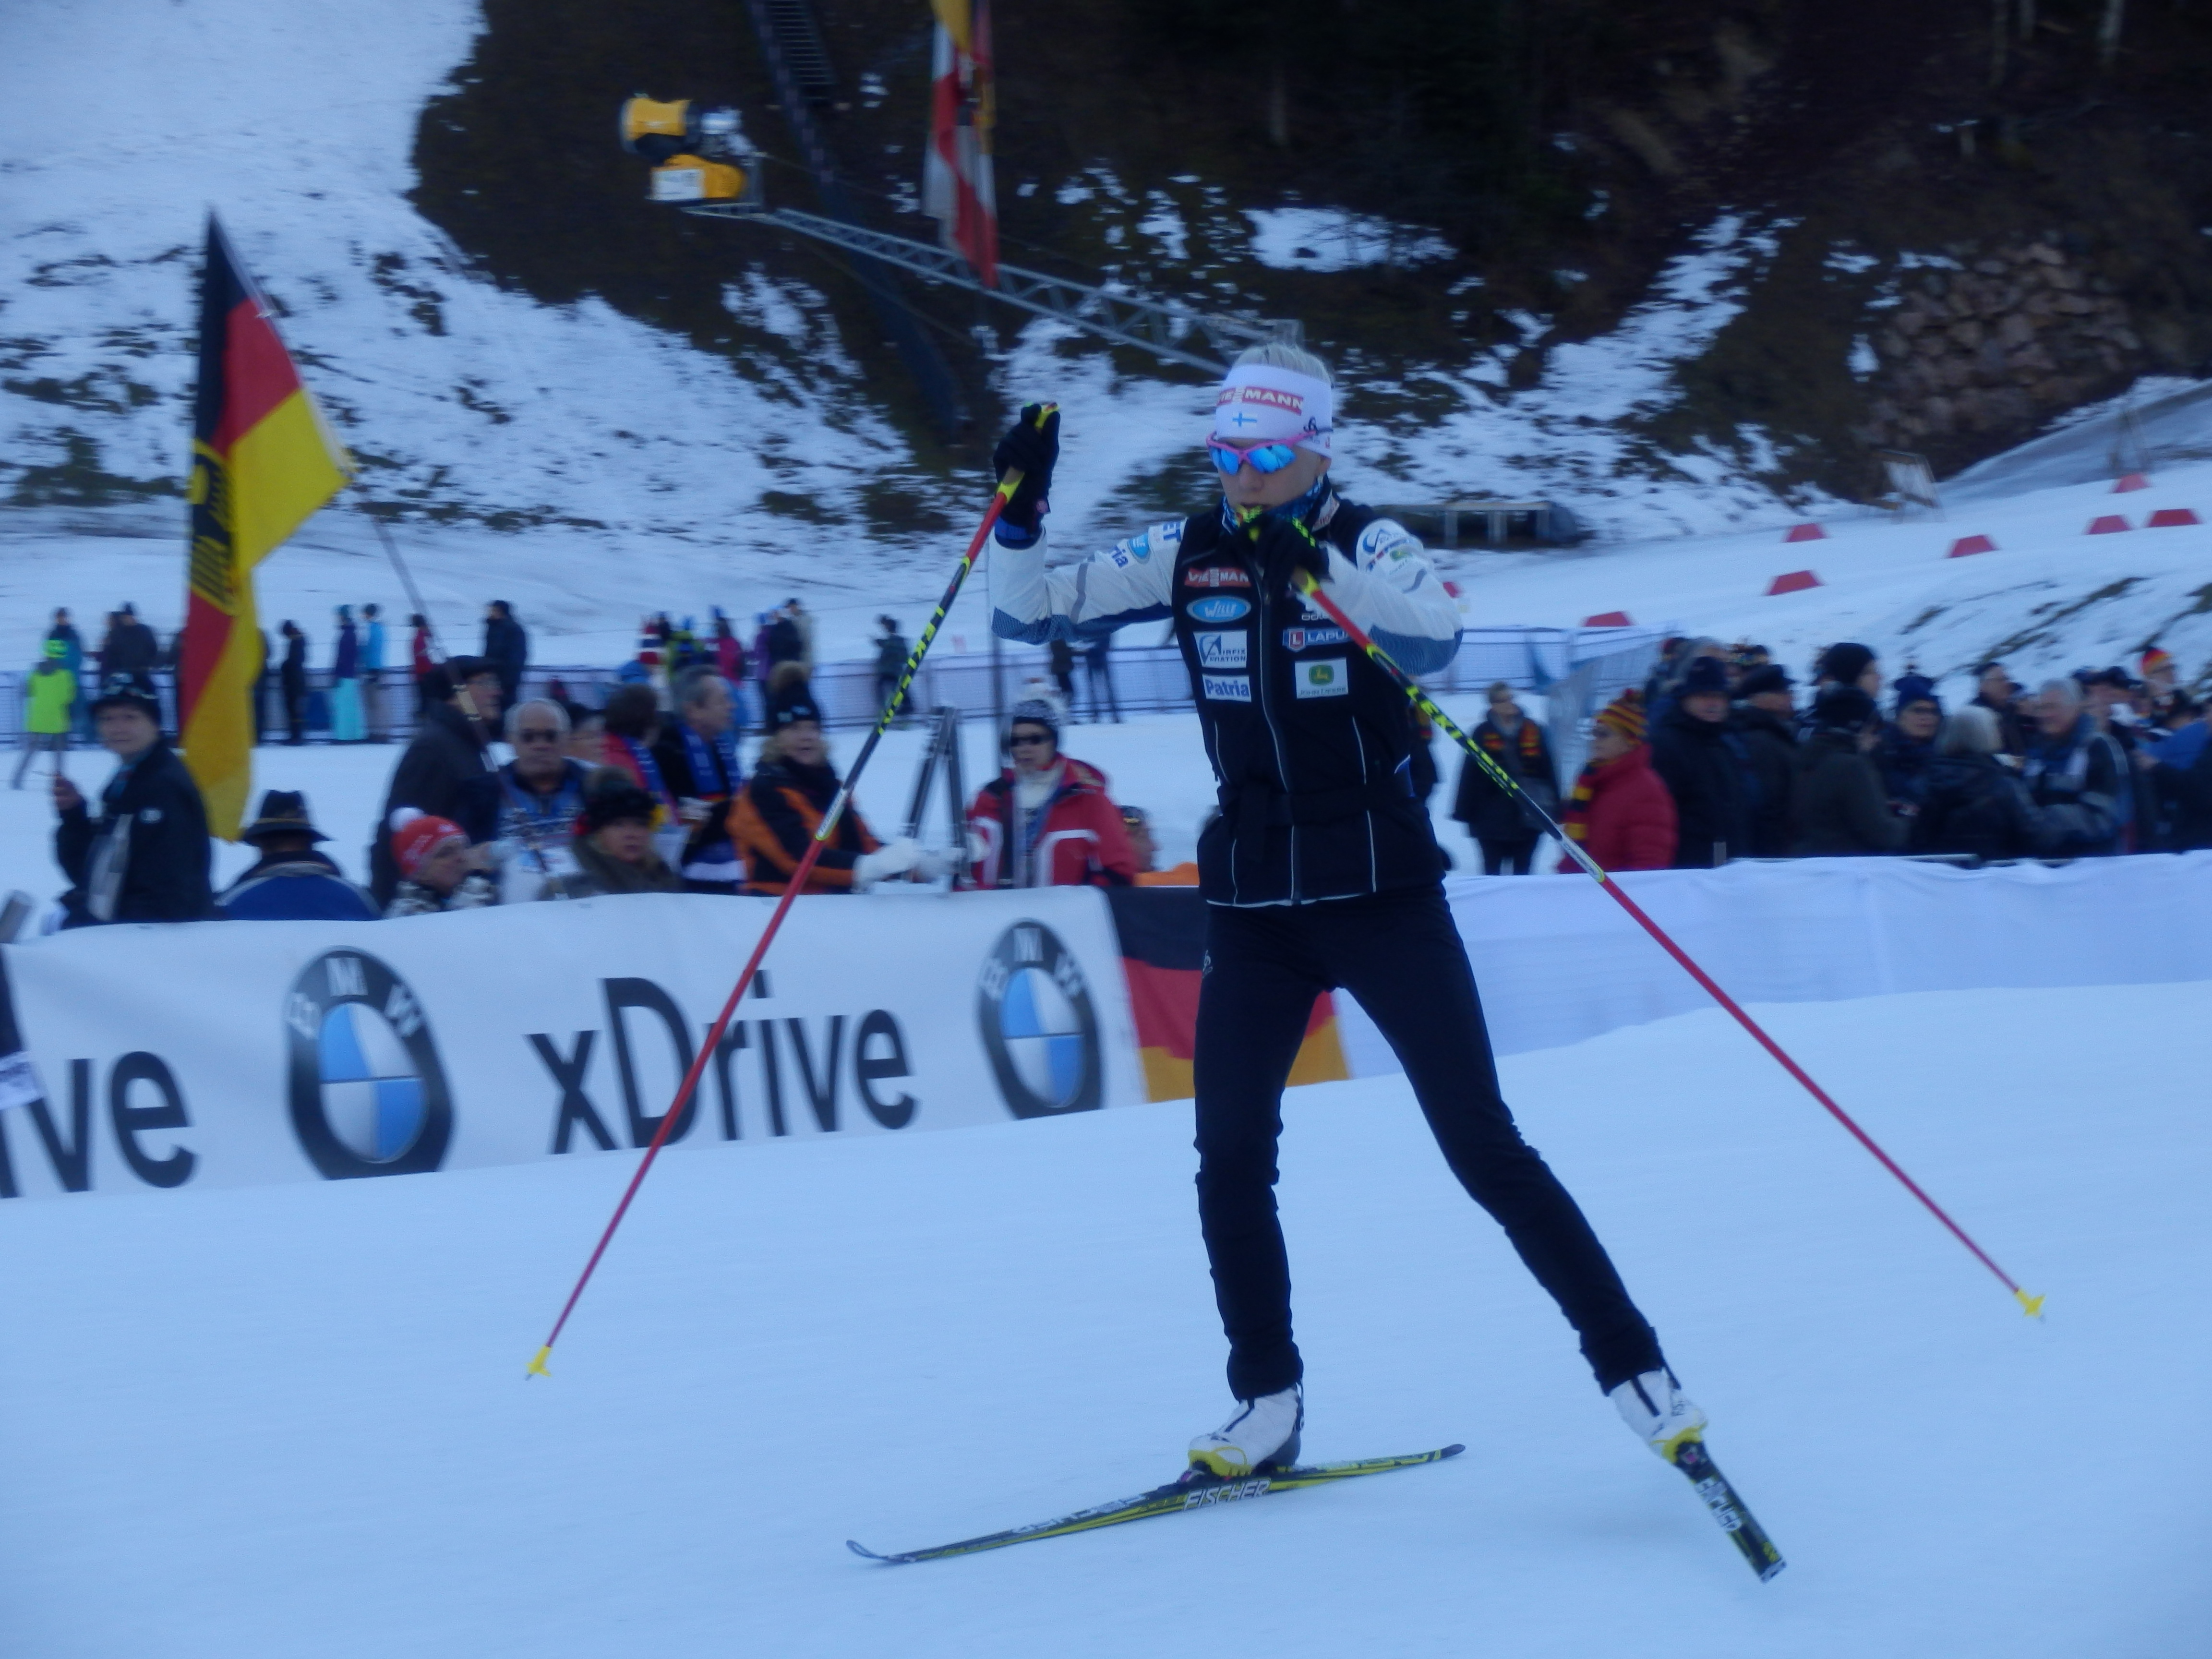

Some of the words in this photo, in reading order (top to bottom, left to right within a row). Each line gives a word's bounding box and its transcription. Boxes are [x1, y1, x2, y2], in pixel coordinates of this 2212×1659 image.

[1308, 629, 1347, 642] LAPU
[1204, 679, 1249, 697] Patria
[524, 969, 920, 1154] xDrive
[1182, 1479, 1271, 1511] FISCHER
